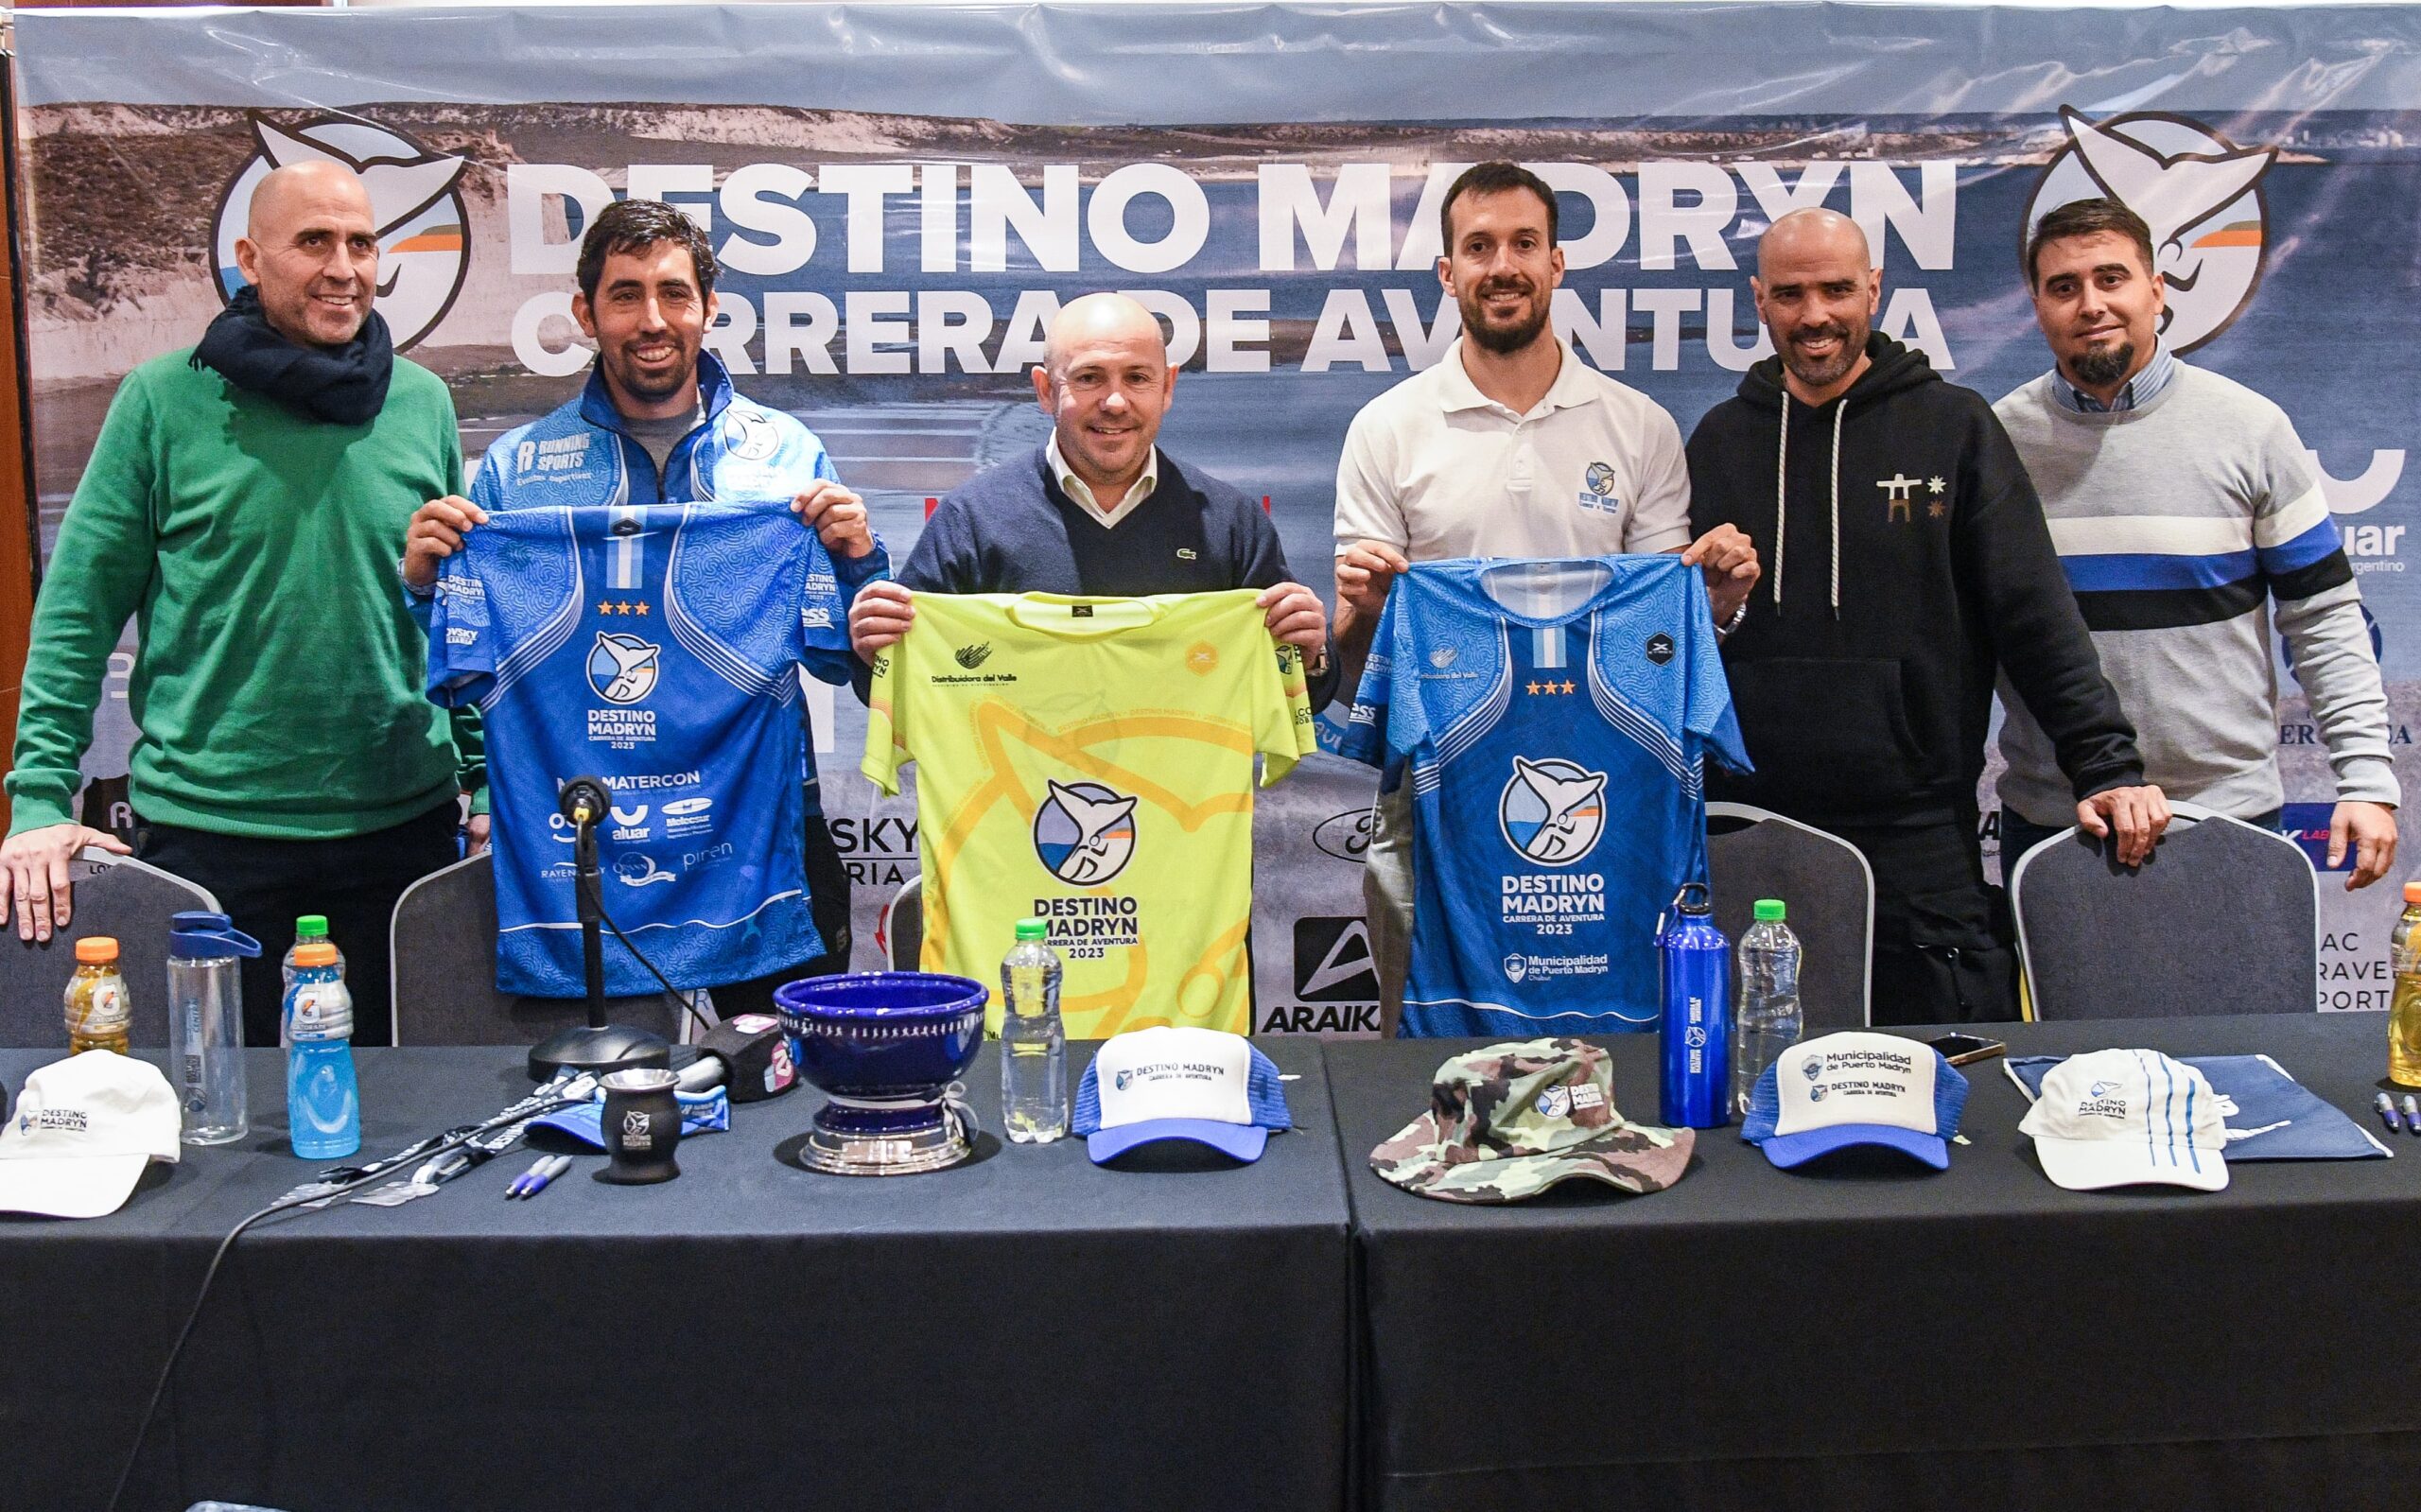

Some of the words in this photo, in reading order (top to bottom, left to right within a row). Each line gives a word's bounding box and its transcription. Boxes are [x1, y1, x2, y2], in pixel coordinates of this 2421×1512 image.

[511, 290, 1057, 376] CRERA
[1300, 287, 1956, 373] AVNTUA
[539, 433, 590, 455] RUNNING
[537, 451, 584, 471] SPORTS
[2351, 560, 2405, 574] rgentino
[998, 673, 1017, 682] Valle
[588, 710, 655, 722] DESTINO
[588, 723, 656, 736] MADRYN
[601, 771, 701, 791] MATERCON
[612, 827, 651, 841] aluar
[1502, 873, 1605, 894] DESTINO
[1034, 897, 1137, 916] DESTINO
[1502, 894, 1605, 913] MADRYN
[1559, 913, 1605, 922] AVENTURA
[1537, 924, 1573, 934] 2023
[1091, 937, 1138, 946] AVENTURA
[1069, 947, 1105, 958] 2023
[1528, 953, 1608, 965] Municipalidad
[1528, 965, 1539, 973] de
[1541, 965, 1573, 974] Puerto
[1575, 965, 1609, 976] Madryn
[1262, 1005, 1381, 1033] ARAIK
[1826, 1050, 1911, 1065] Municipalidad
[1137, 1062, 1178, 1076] DESTINO
[1183, 1063, 1224, 1075] MADRYN
[1879, 1061, 1911, 1073] Madryn
[1831, 1081, 1869, 1090] DESTINO
[1872, 1081, 1906, 1092] MADRYN
[2079, 1105, 2126, 1115] MADRYN
[41, 1118, 87, 1128] MADRYN
